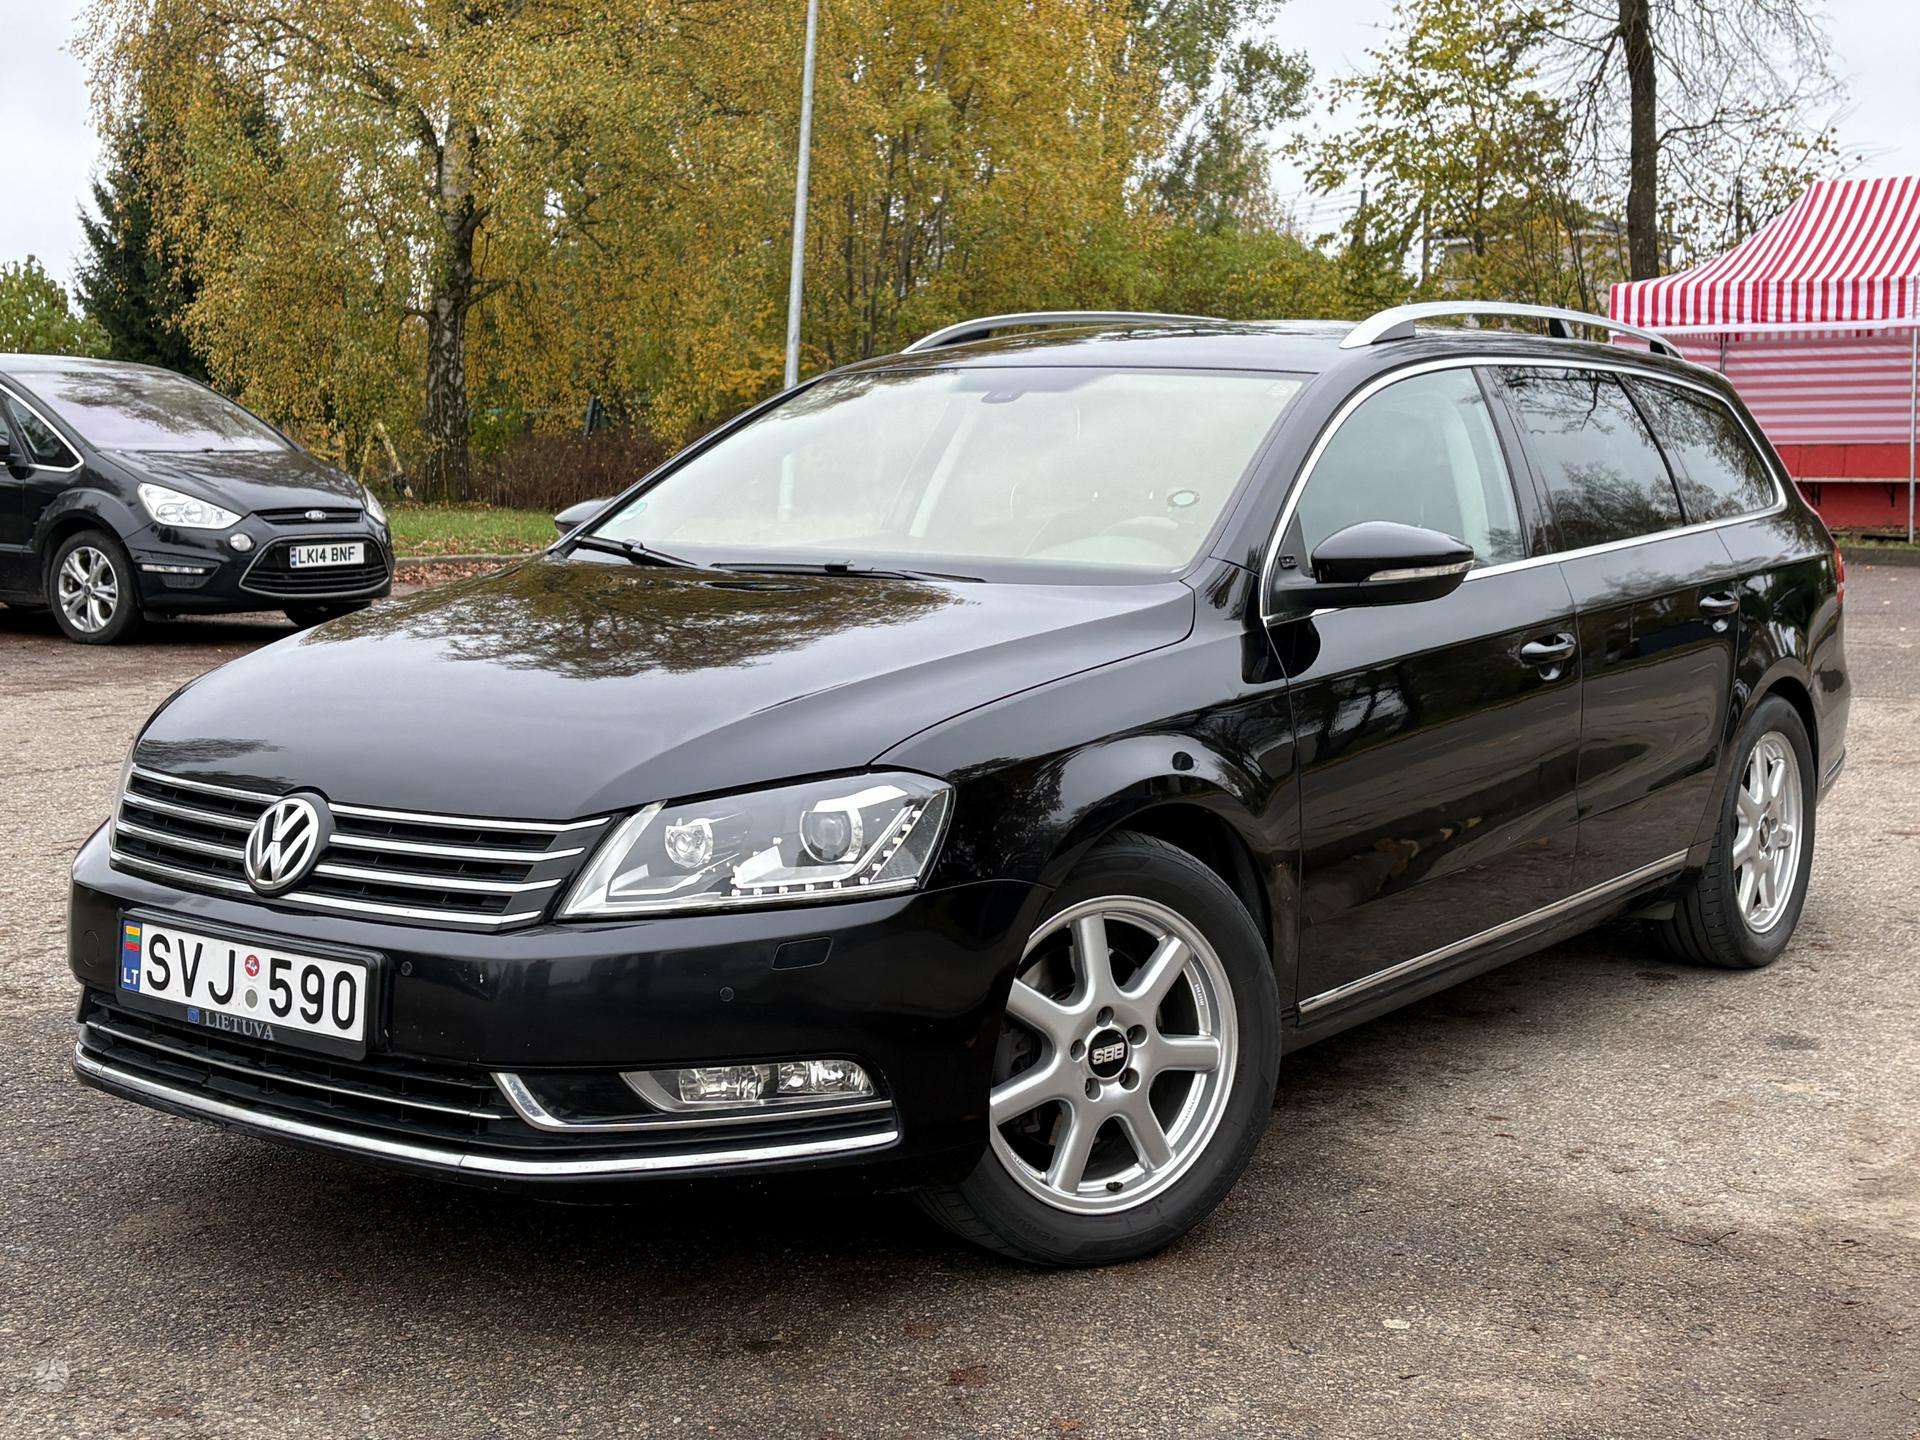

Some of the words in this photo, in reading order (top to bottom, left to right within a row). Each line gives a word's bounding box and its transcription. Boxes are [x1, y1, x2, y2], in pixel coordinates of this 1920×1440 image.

[299, 548, 327, 564] LK14
[331, 546, 356, 562] BNF
[123, 967, 139, 985] LT
[146, 933, 237, 1005] SVJ
[268, 957, 357, 1031] 590
[204, 1011, 275, 1041] LIETUVA
